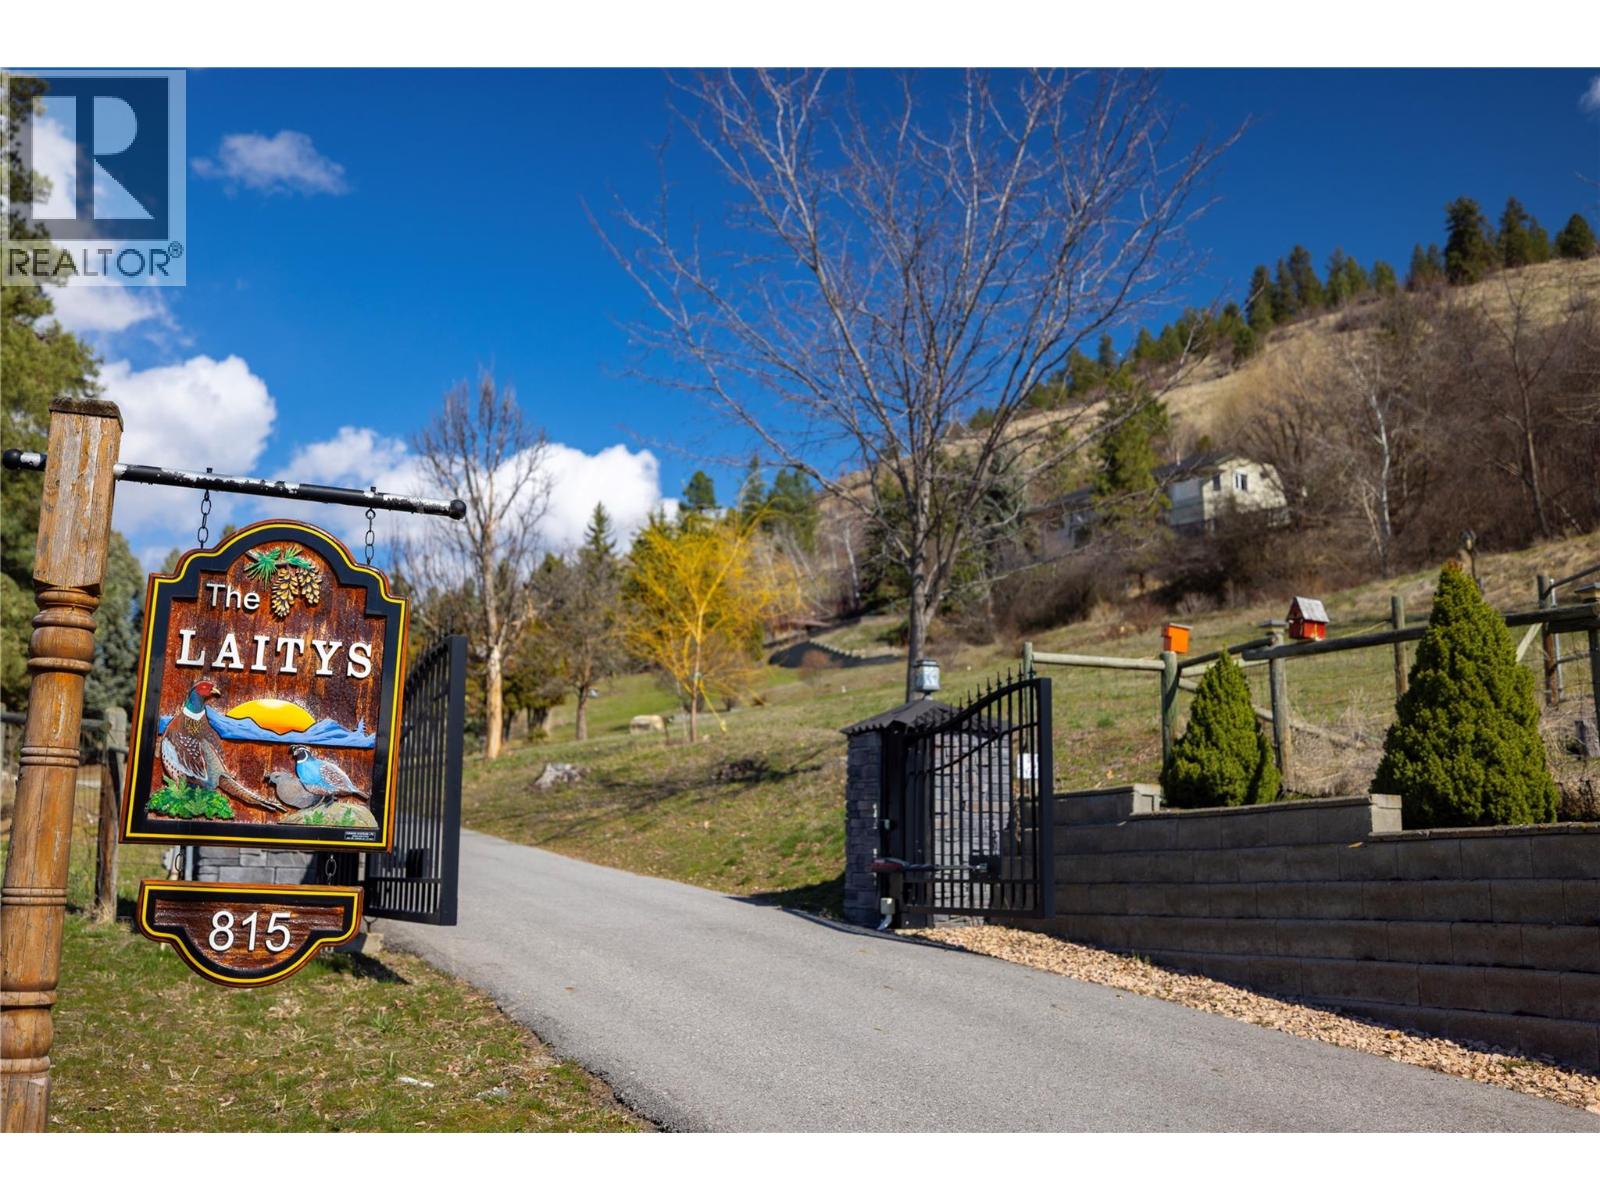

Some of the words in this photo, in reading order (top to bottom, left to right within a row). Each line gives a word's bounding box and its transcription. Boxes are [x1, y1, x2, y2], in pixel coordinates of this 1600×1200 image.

[206, 583, 261, 611] The
[176, 629, 373, 679] LAITYS
[208, 910, 291, 952] 815
